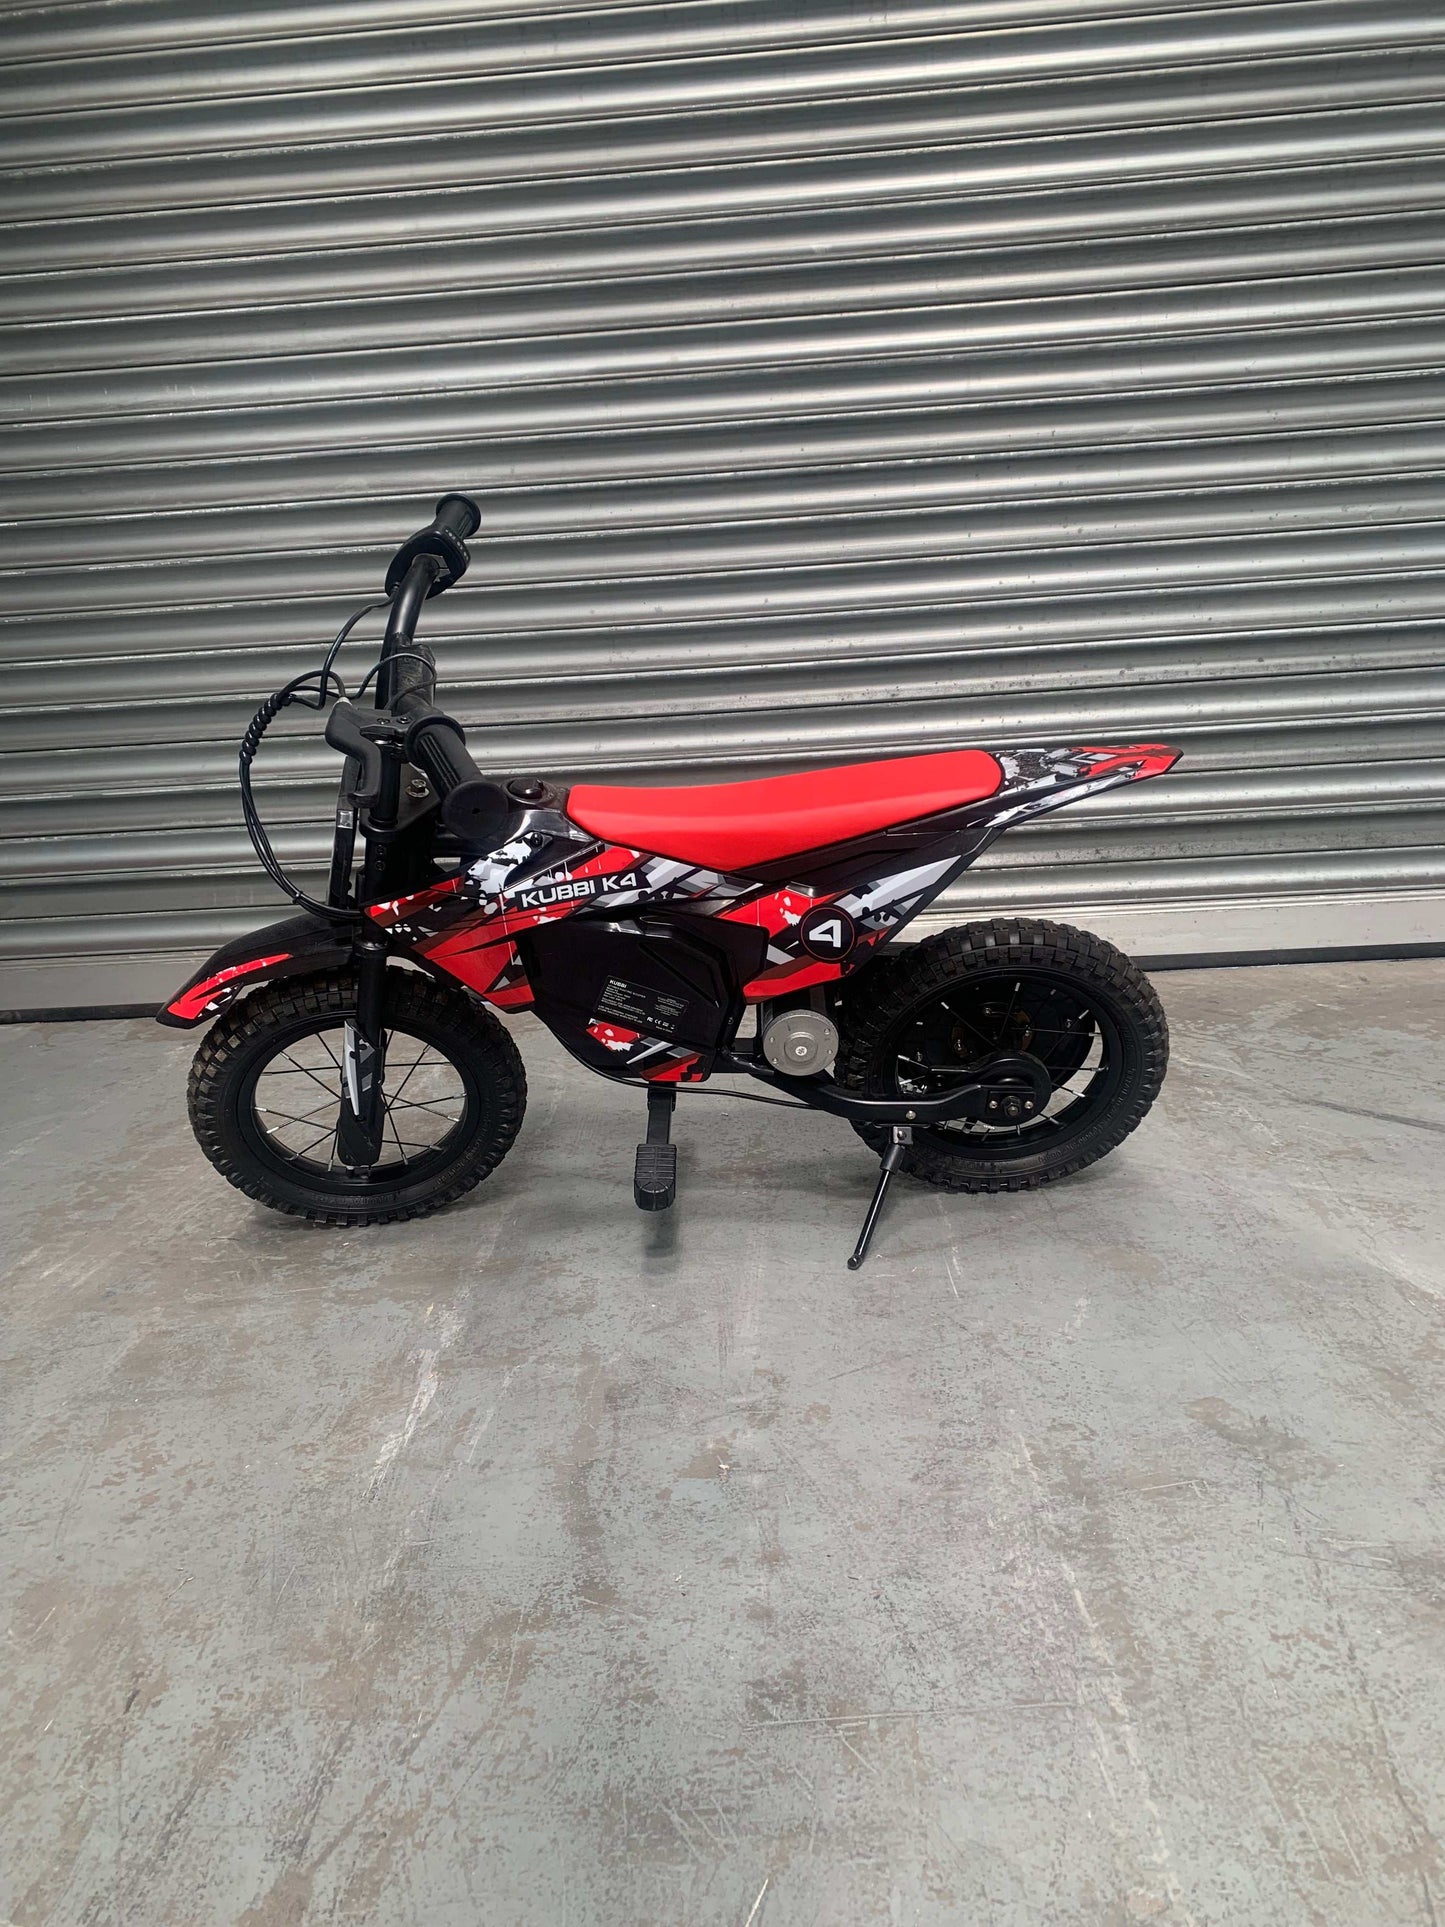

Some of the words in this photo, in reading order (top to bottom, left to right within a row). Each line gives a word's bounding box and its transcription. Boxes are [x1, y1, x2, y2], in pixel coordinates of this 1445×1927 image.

[521, 879, 596, 908] KUBBI
[602, 872, 637, 891] K4
[809, 919, 841, 948] 4
